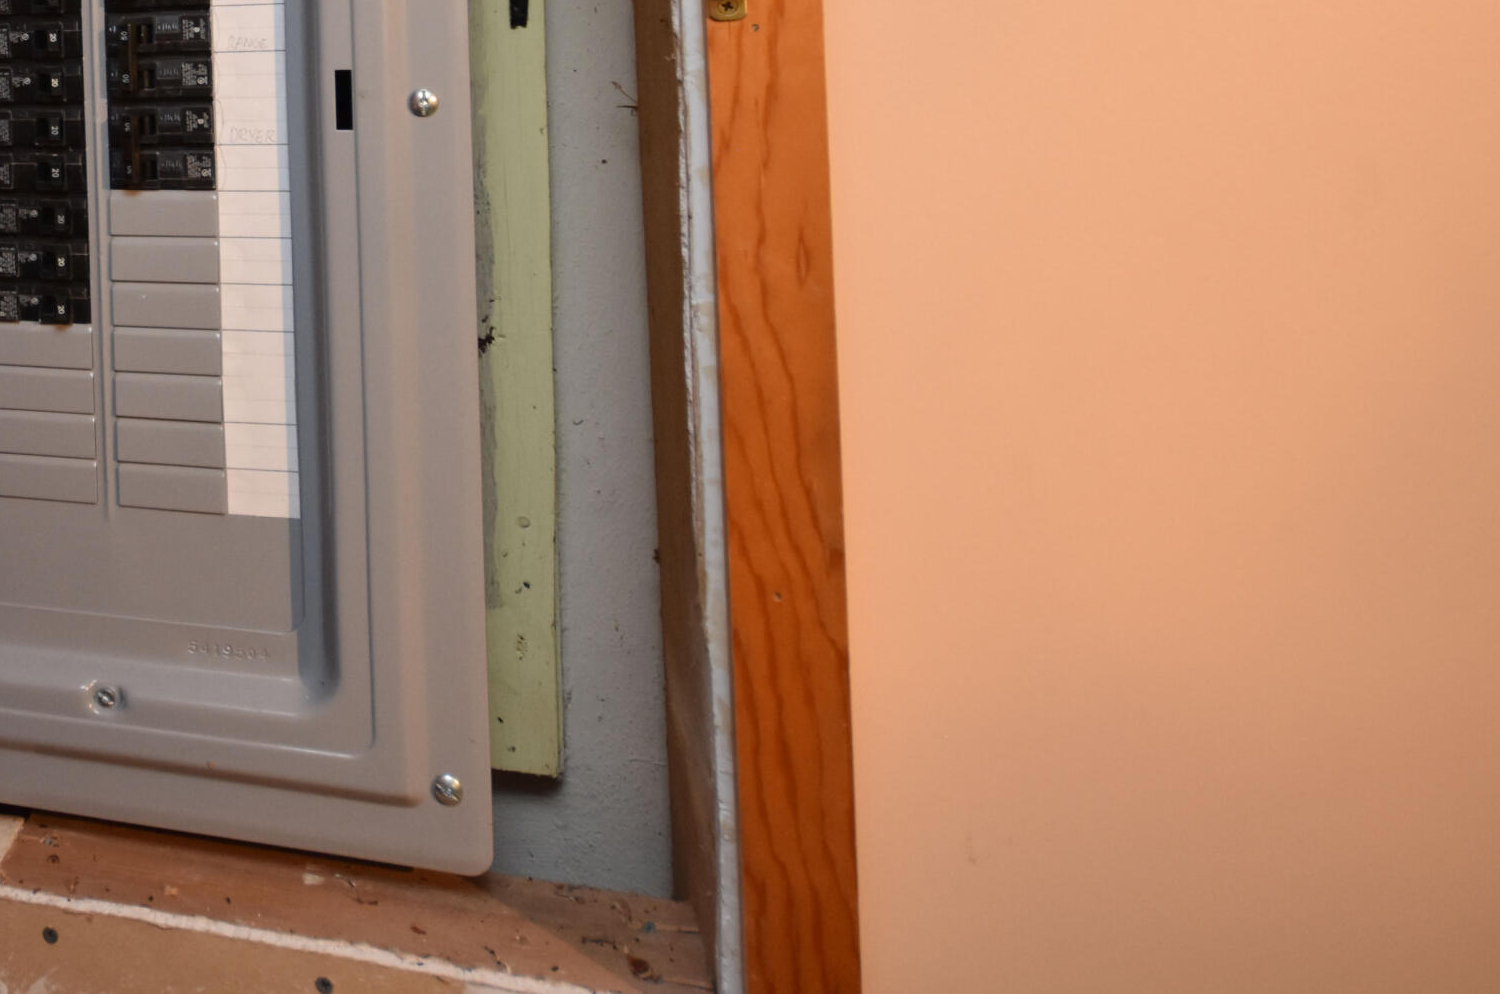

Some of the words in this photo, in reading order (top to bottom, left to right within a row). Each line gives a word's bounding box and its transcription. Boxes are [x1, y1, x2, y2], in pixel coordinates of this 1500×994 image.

[48, 32, 57, 43] 20
[227, 35, 269, 51] RANGE
[50, 77, 59, 88] 20
[50, 125, 59, 136] 20
[229, 126, 277, 144] DRYER
[50, 167, 60, 178] 20
[57, 214, 66, 224] 20
[57, 257, 66, 267] 20
[57, 305, 66, 315] 20
[186, 639, 271, 664] 5419504
